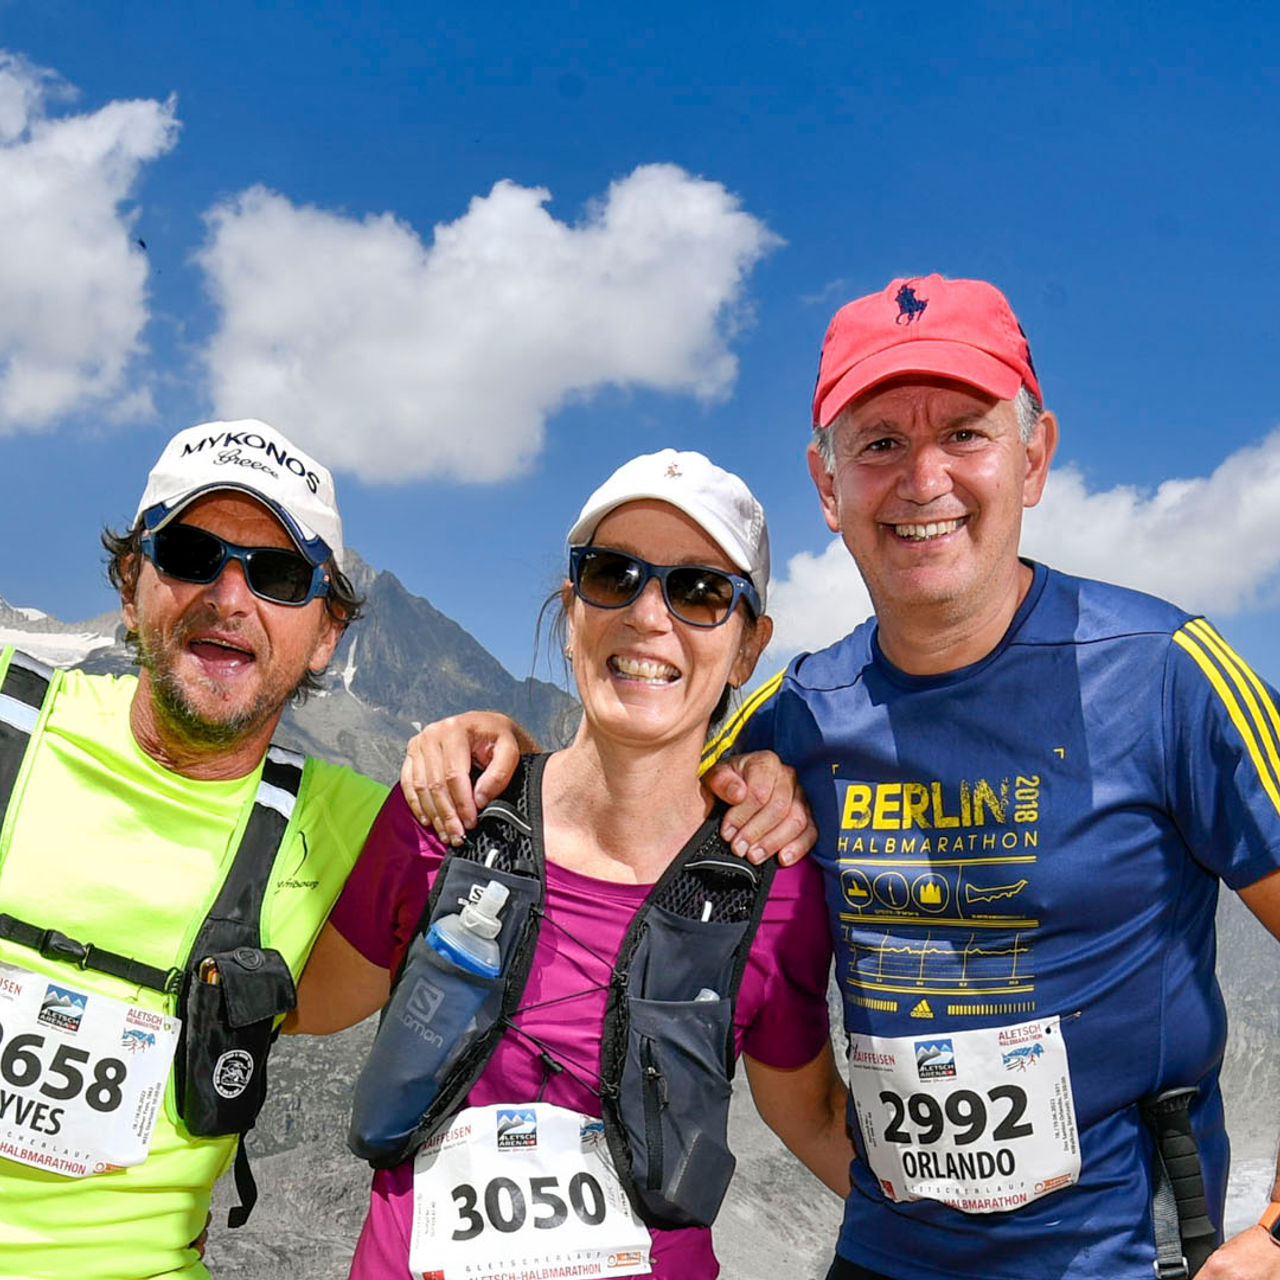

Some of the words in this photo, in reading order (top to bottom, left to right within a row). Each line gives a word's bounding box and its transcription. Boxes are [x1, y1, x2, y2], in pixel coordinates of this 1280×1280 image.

[181, 431, 320, 494] MYKONOS
[213, 448, 279, 479] Greece
[841, 777, 1009, 830] BERLIN
[1014, 775, 1040, 823] 2018
[837, 831, 1038, 853] HALBMARATHON
[127, 1007, 163, 1025] ALETSCH
[999, 1024, 1041, 1040] ALETSCH
[880, 1085, 1034, 1146] 2992
[903, 1149, 1015, 1180] ORLANDO
[451, 1172, 606, 1241] 3050
[466, 1251, 601, 1272] GLETSCHERLAUF
